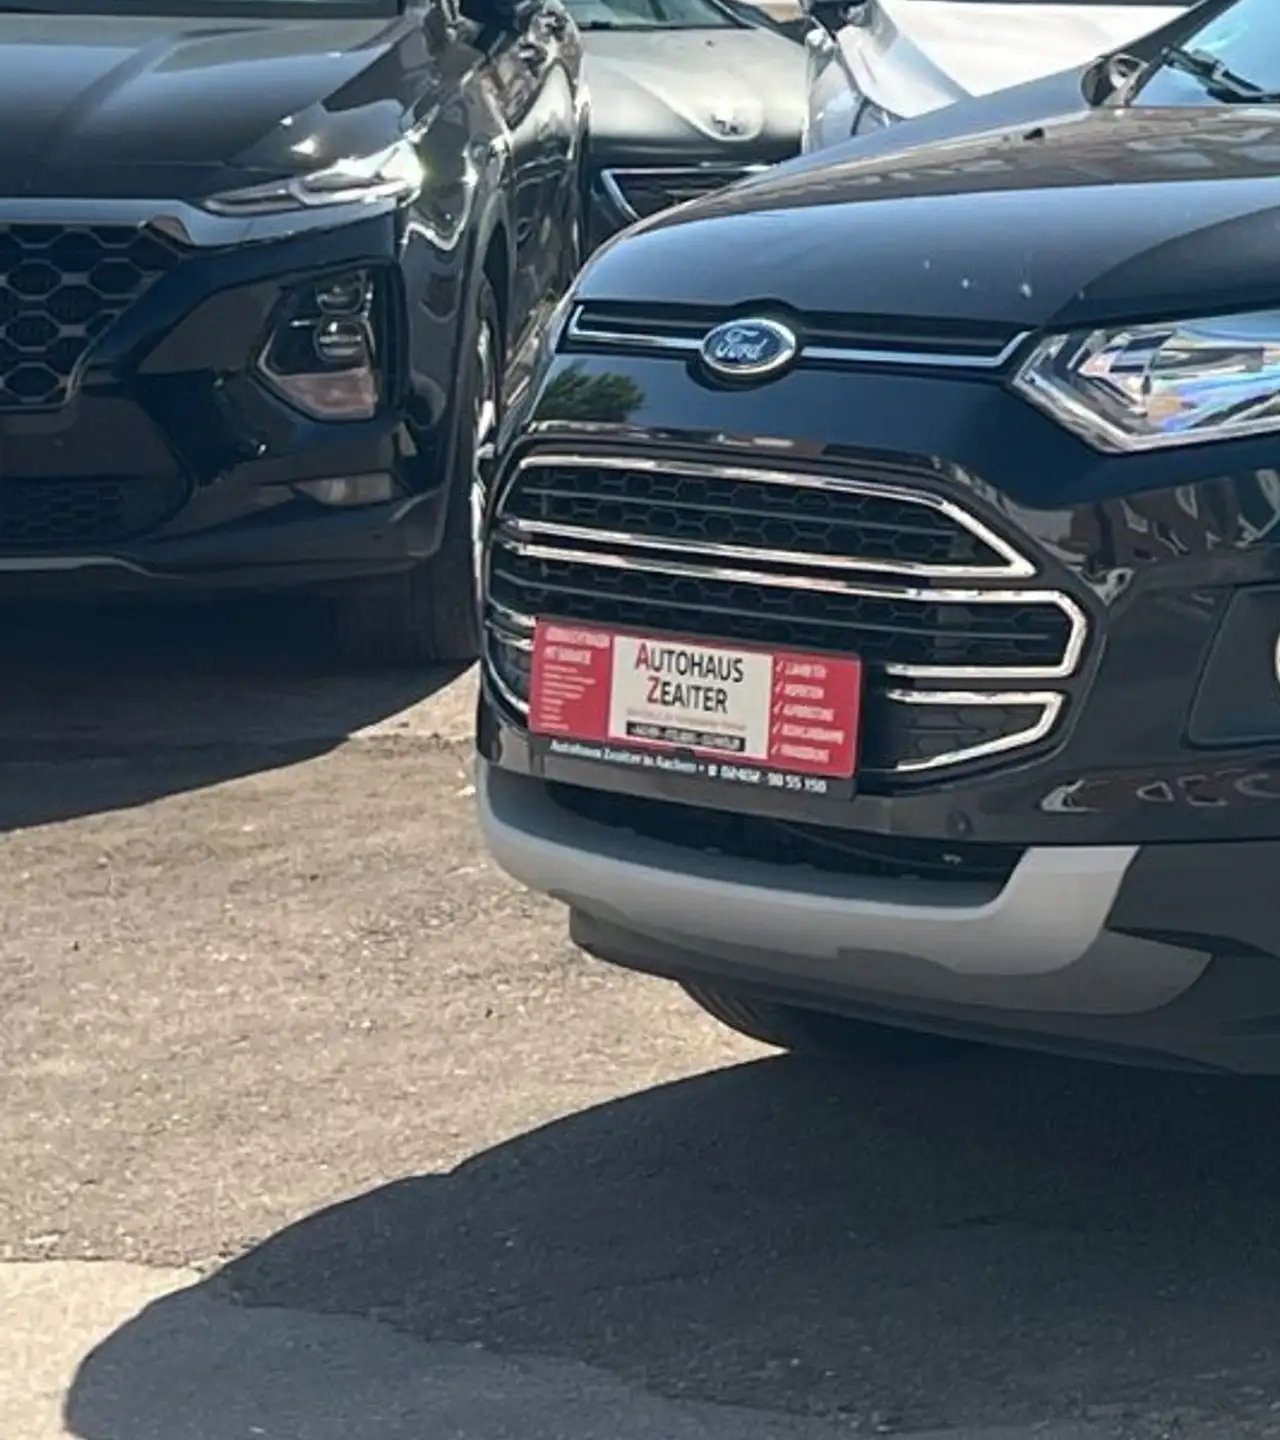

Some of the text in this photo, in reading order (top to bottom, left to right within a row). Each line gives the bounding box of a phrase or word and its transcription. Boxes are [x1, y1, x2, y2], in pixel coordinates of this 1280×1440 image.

[714, 326, 770, 361] Ford
[634, 641, 744, 683] AUTOHAUS
[645, 674, 728, 714] ZEAITER
